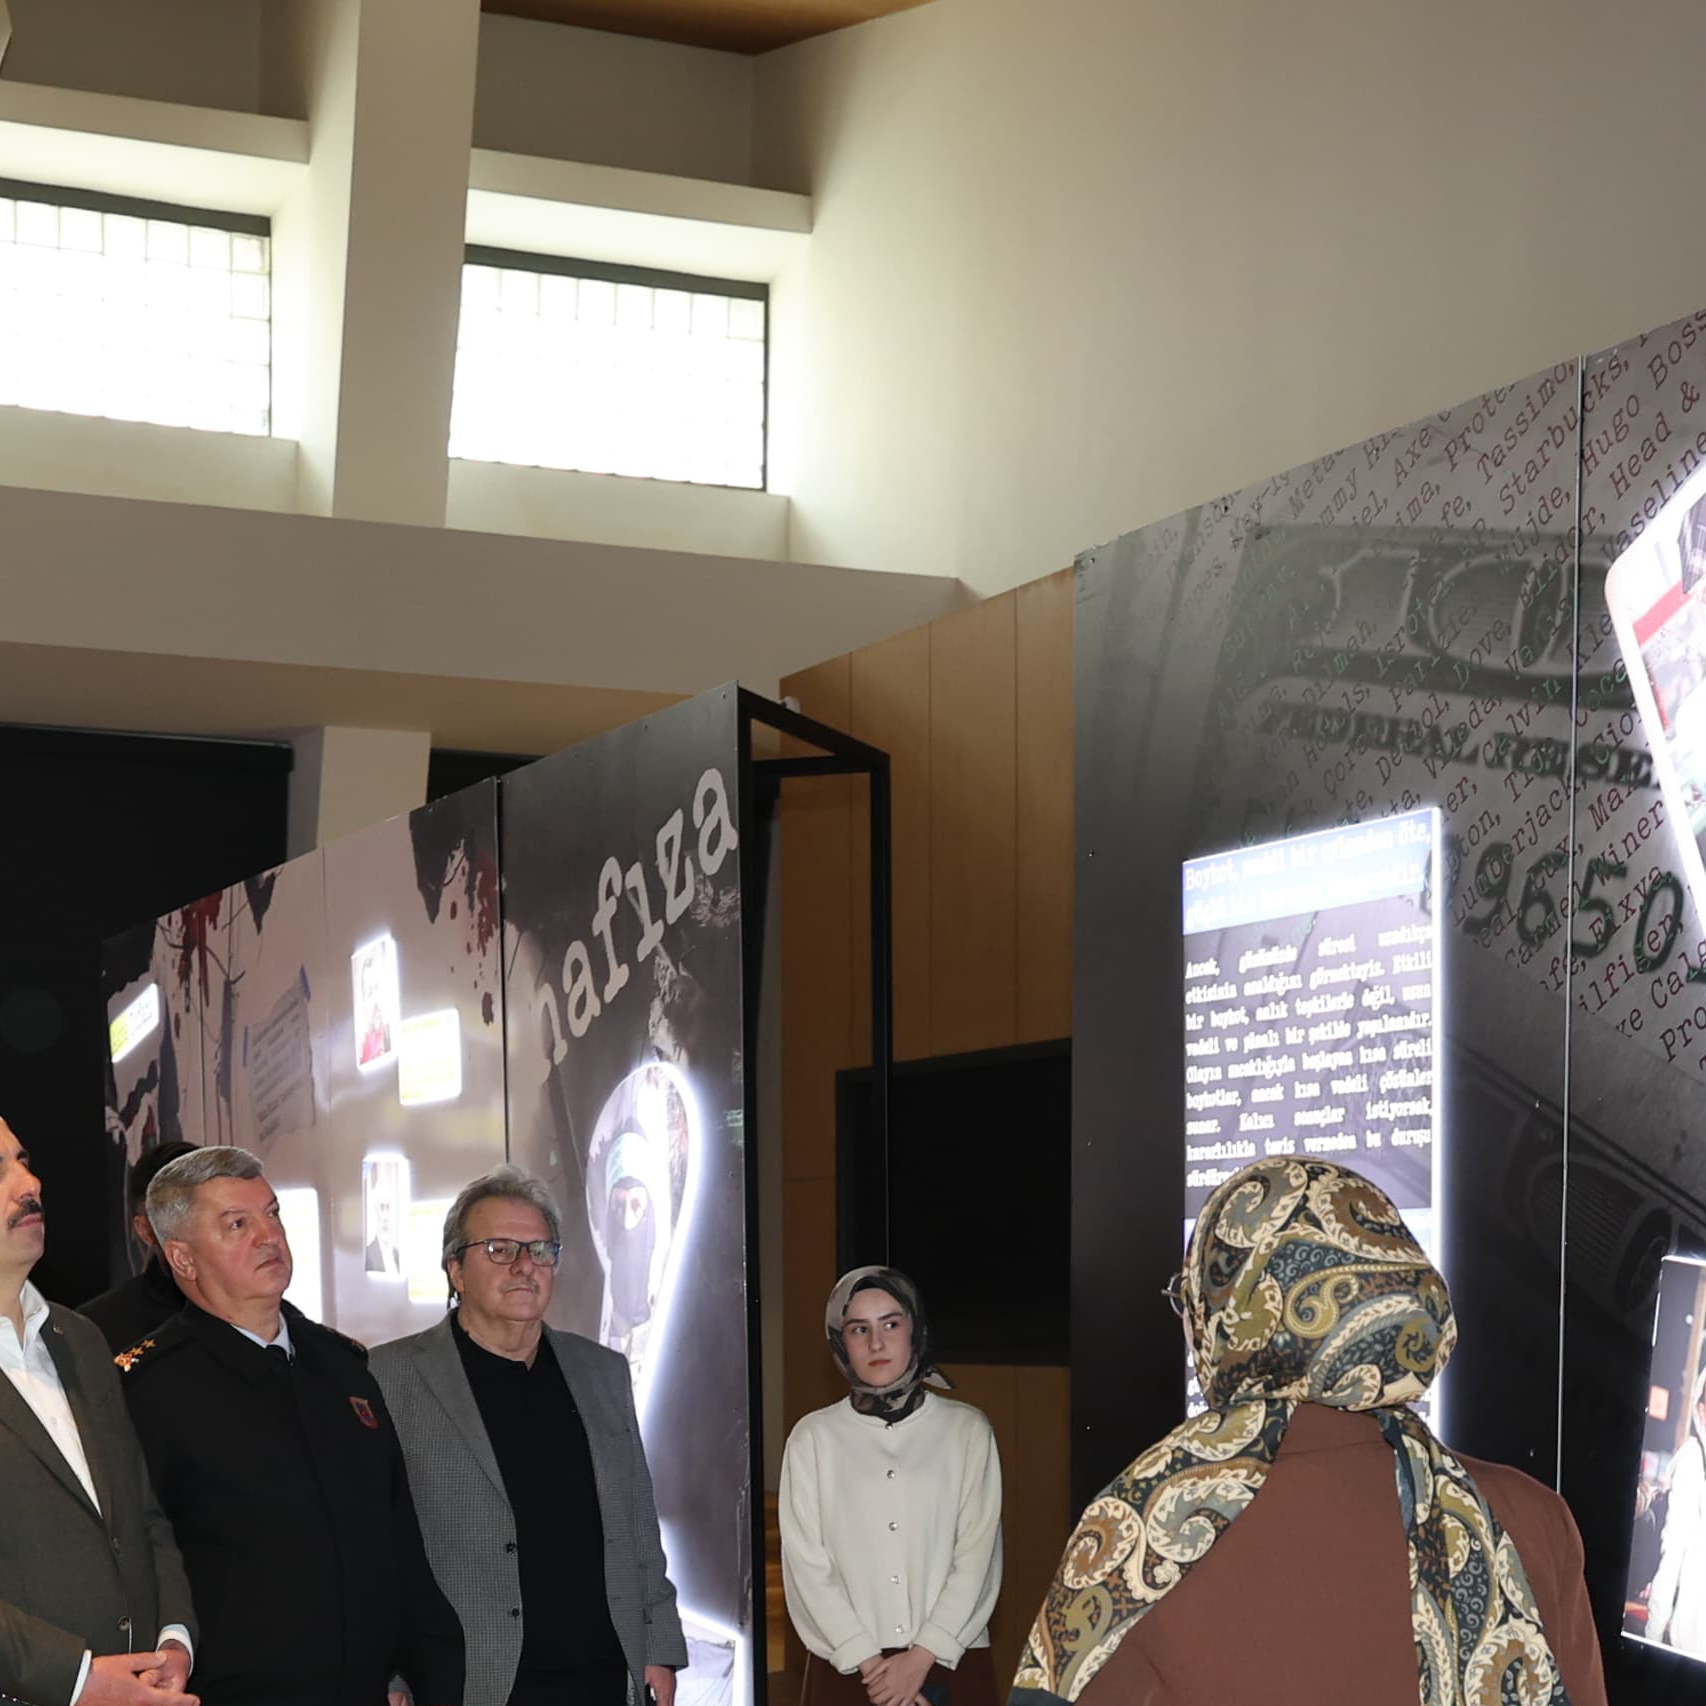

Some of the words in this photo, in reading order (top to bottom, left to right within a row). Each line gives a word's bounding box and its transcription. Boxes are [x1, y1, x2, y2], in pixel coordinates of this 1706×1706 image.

[1393, 423, 1436, 491] Axe
[1475, 360, 1577, 484] Tassimo,
[1496, 353, 1632, 517] Starbucks,
[1577, 393, 1645, 480] Hugo
[1606, 411, 1674, 501] Head
[1677, 377, 1702, 413] &
[1452, 774, 1588, 927] Lumberjack,
[1210, 1005, 1251, 1031] boykot,
